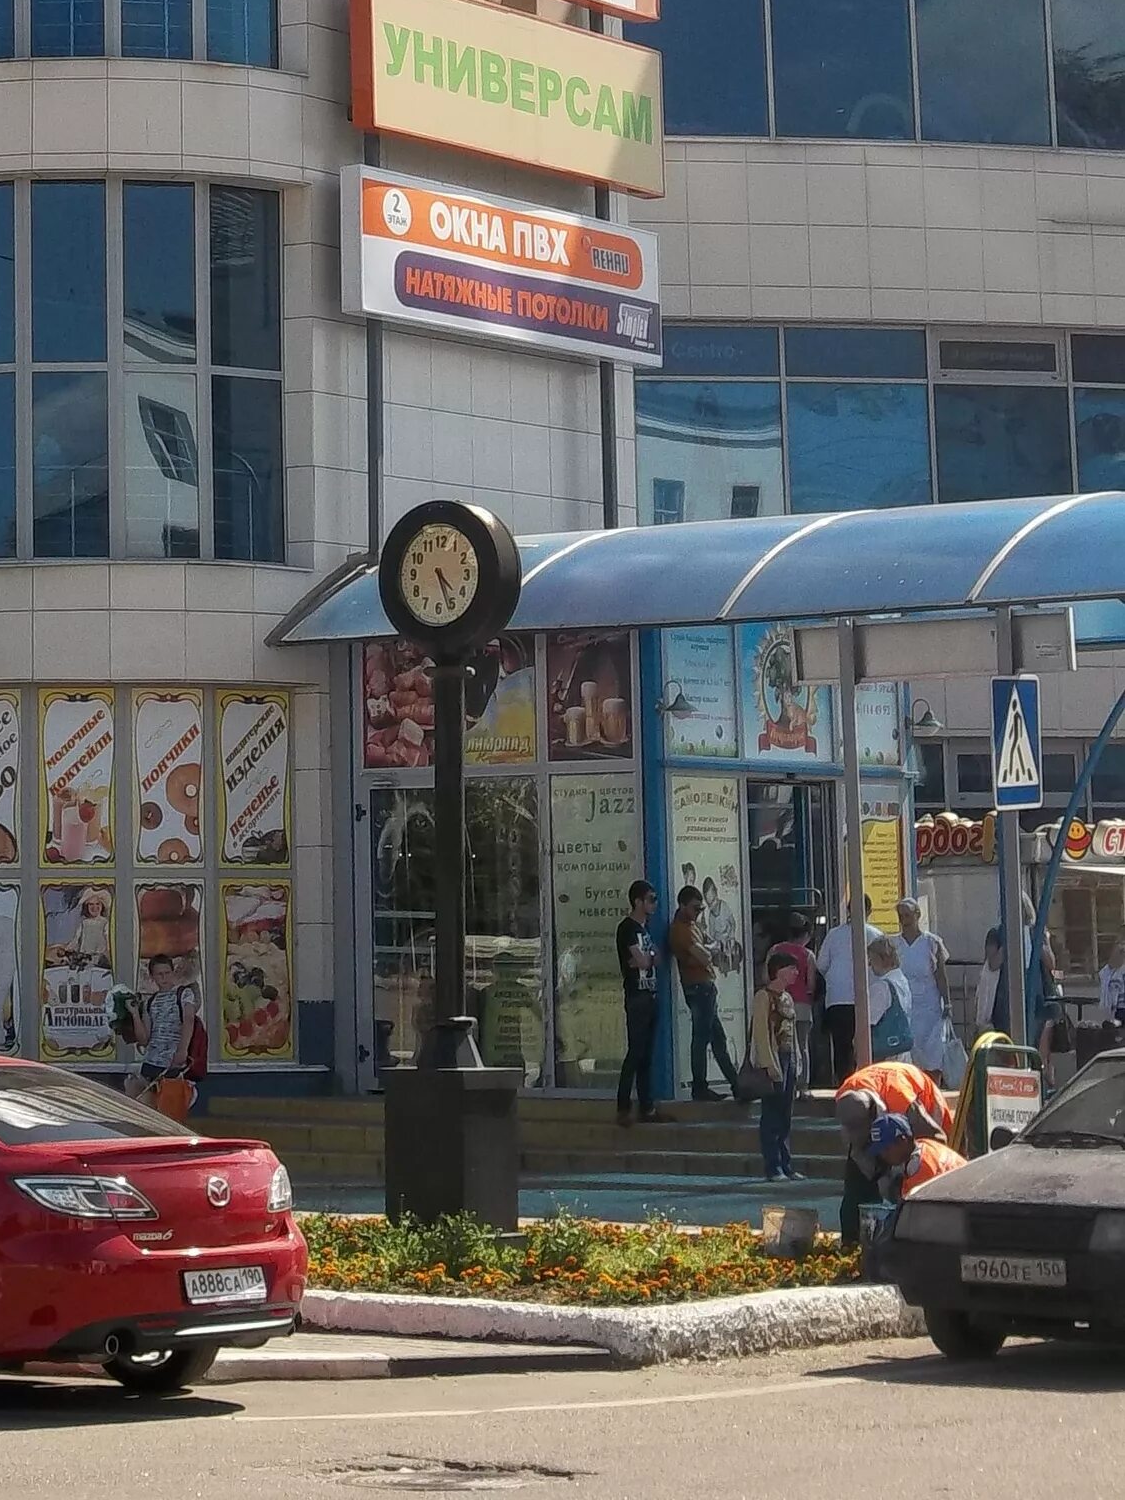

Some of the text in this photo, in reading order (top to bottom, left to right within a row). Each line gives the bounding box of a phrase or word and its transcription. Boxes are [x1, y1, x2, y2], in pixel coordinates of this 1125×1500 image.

[383, 21, 655, 147] УНИВЕРСАМ
[392, 192, 402, 213] 2
[387, 215, 408, 227] ЭТАЖ
[429, 201, 571, 268] ОКНА ПВХ
[591, 247, 630, 276] REHAU
[406, 267, 610, 333] НАТЯЖНЫЕ ПОТОЛКИ
[423, 540, 433, 553] 11
[435, 535, 448, 548] 12
[453, 540, 458, 552] 1
[412, 552, 424, 565] 10
[460, 552, 467, 565] 2
[410, 568, 417, 581] 9
[463, 569, 470, 581] 3
[413, 585, 420, 597] 8
[459, 585, 466, 598] 4
[422, 597, 429, 610] 7
[435, 602, 442, 615] 6
[449, 597, 456, 610] 5
[46, 709, 106, 770] молочные
[48, 731, 113, 797] коктейли
[141, 723, 200, 793] пончики
[599, 787, 634, 797] цветов
[229, 775, 280, 839] печенье
[586, 791, 635, 822] Jazz
[1036, 1260, 1062, 1276] 150
[242, 1268, 263, 1286] 190
